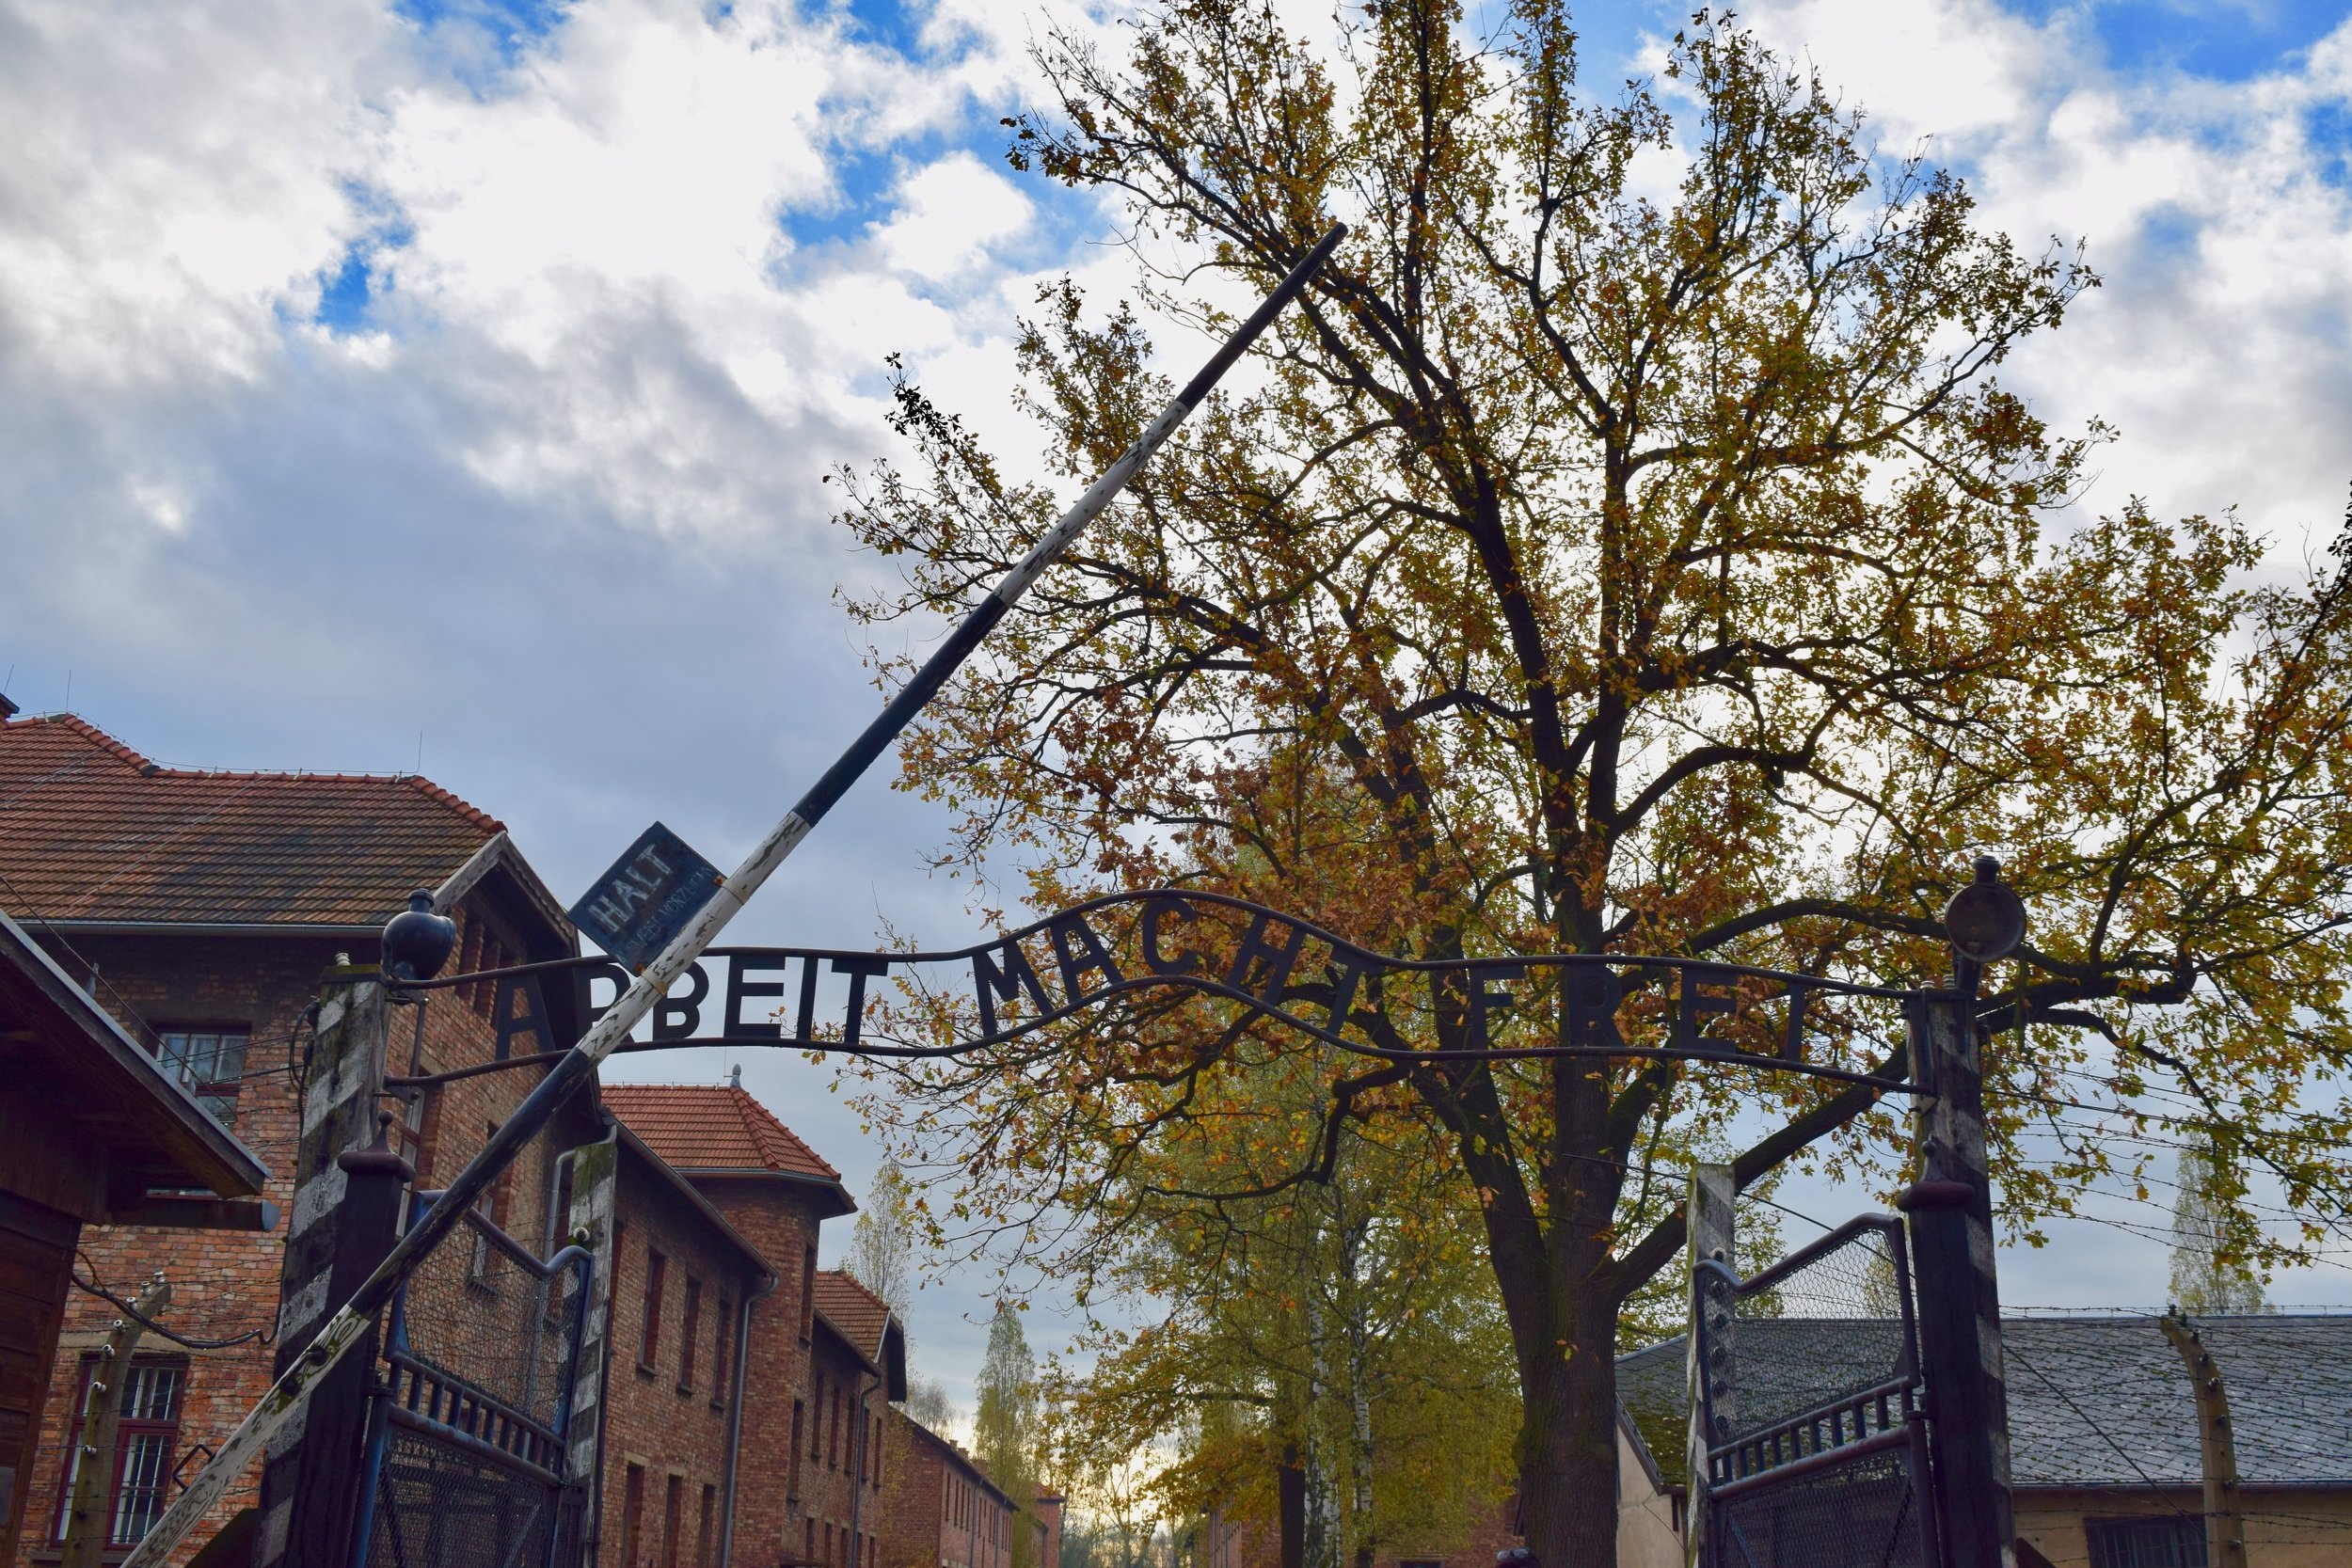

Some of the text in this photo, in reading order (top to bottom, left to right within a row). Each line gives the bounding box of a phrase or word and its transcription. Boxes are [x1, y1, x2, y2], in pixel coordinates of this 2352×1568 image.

[588, 843, 675, 933] HALT
[495, 897, 1808, 1063] ARBEIT MACHT FREI
